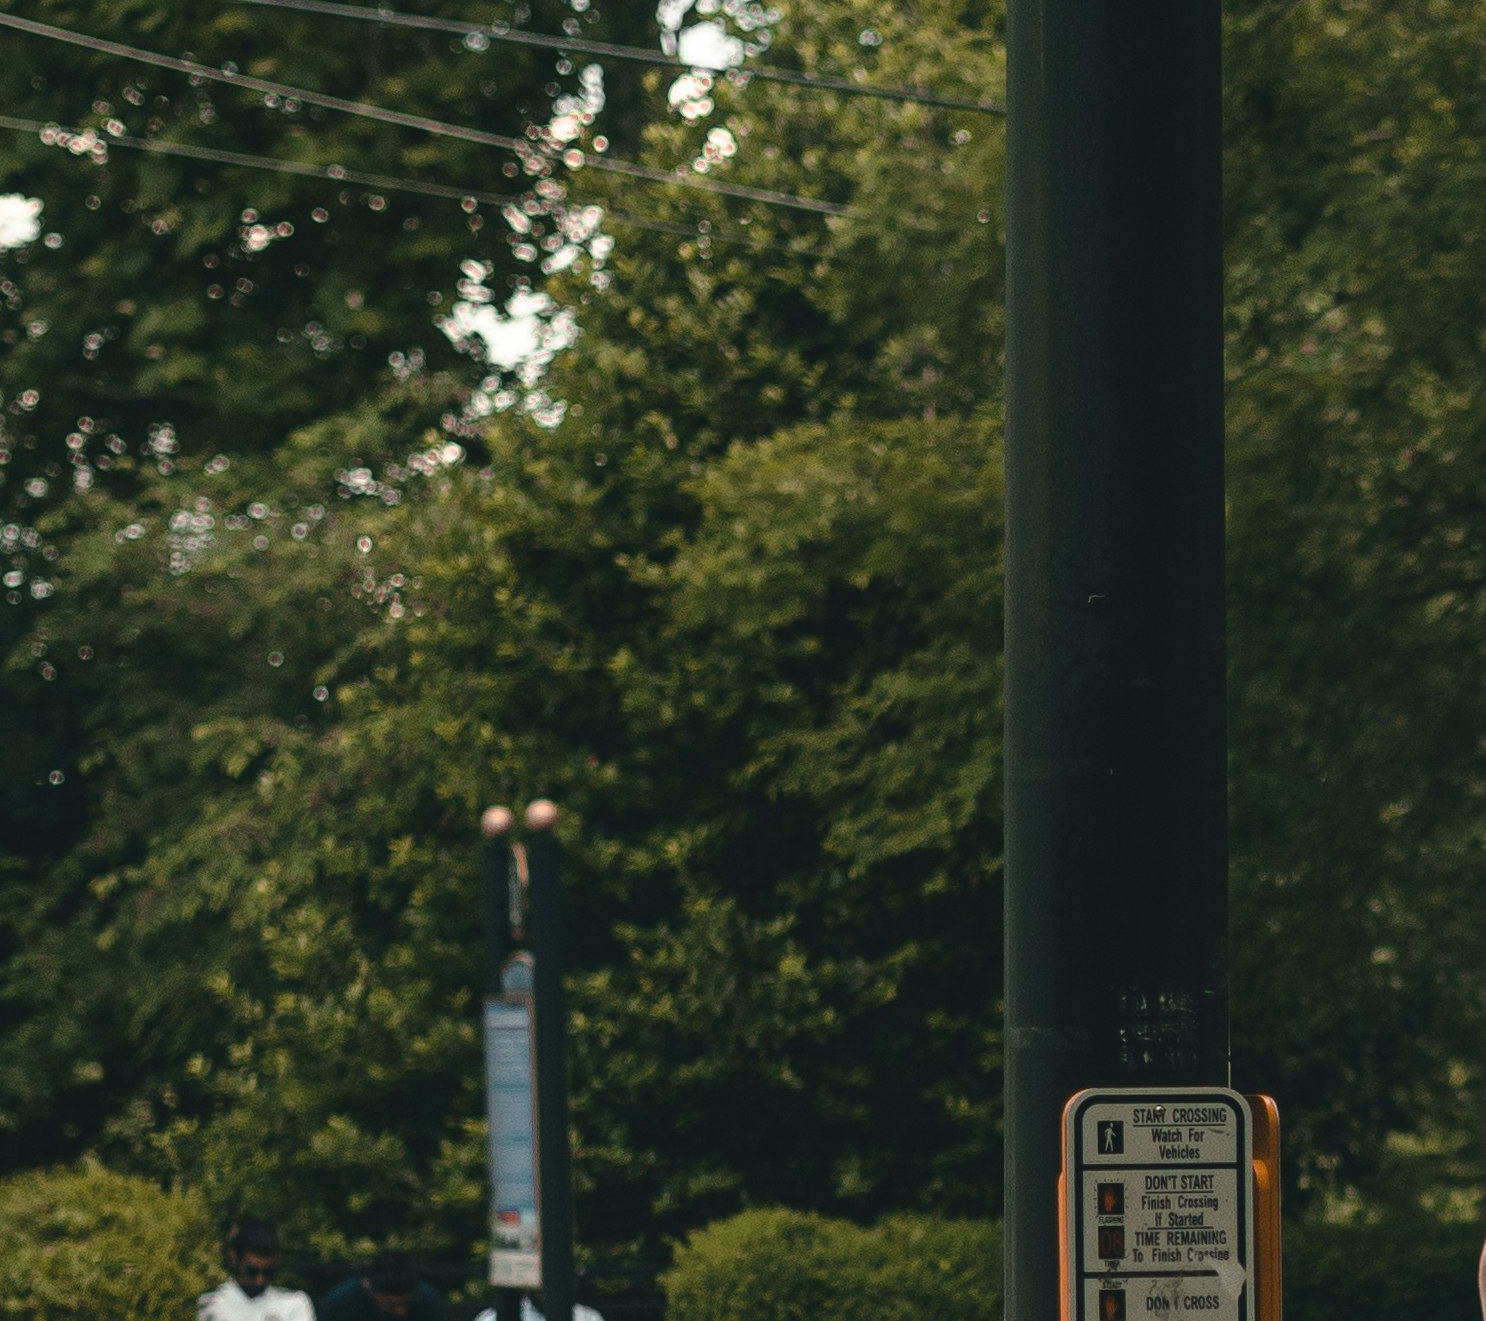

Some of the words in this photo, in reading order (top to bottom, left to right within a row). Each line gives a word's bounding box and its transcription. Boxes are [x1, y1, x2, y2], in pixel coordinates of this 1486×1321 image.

[1133, 1108, 1166, 1123] START
[1172, 1108, 1227, 1123] CROSSING
[1151, 1128, 1182, 1142] Watch
[1188, 1128, 1205, 1142] For
[1159, 1145, 1200, 1159] Vehicles
[1145, 1175, 1178, 1190] DON'T
[1180, 1174, 1214, 1189] START
[1141, 1196, 1171, 1210] Finish
[1178, 1195, 1219, 1211] Crossing
[1155, 1212, 1162, 1226] If
[1168, 1212, 1204, 1226] Started
[1135, 1231, 1160, 1246] TIME
[1167, 1230, 1227, 1246] REMAINING
[1132, 1248, 1144, 1263] To
[1152, 1248, 1182, 1262] Finish
[1184, 1295, 1220, 1310] CROSS
